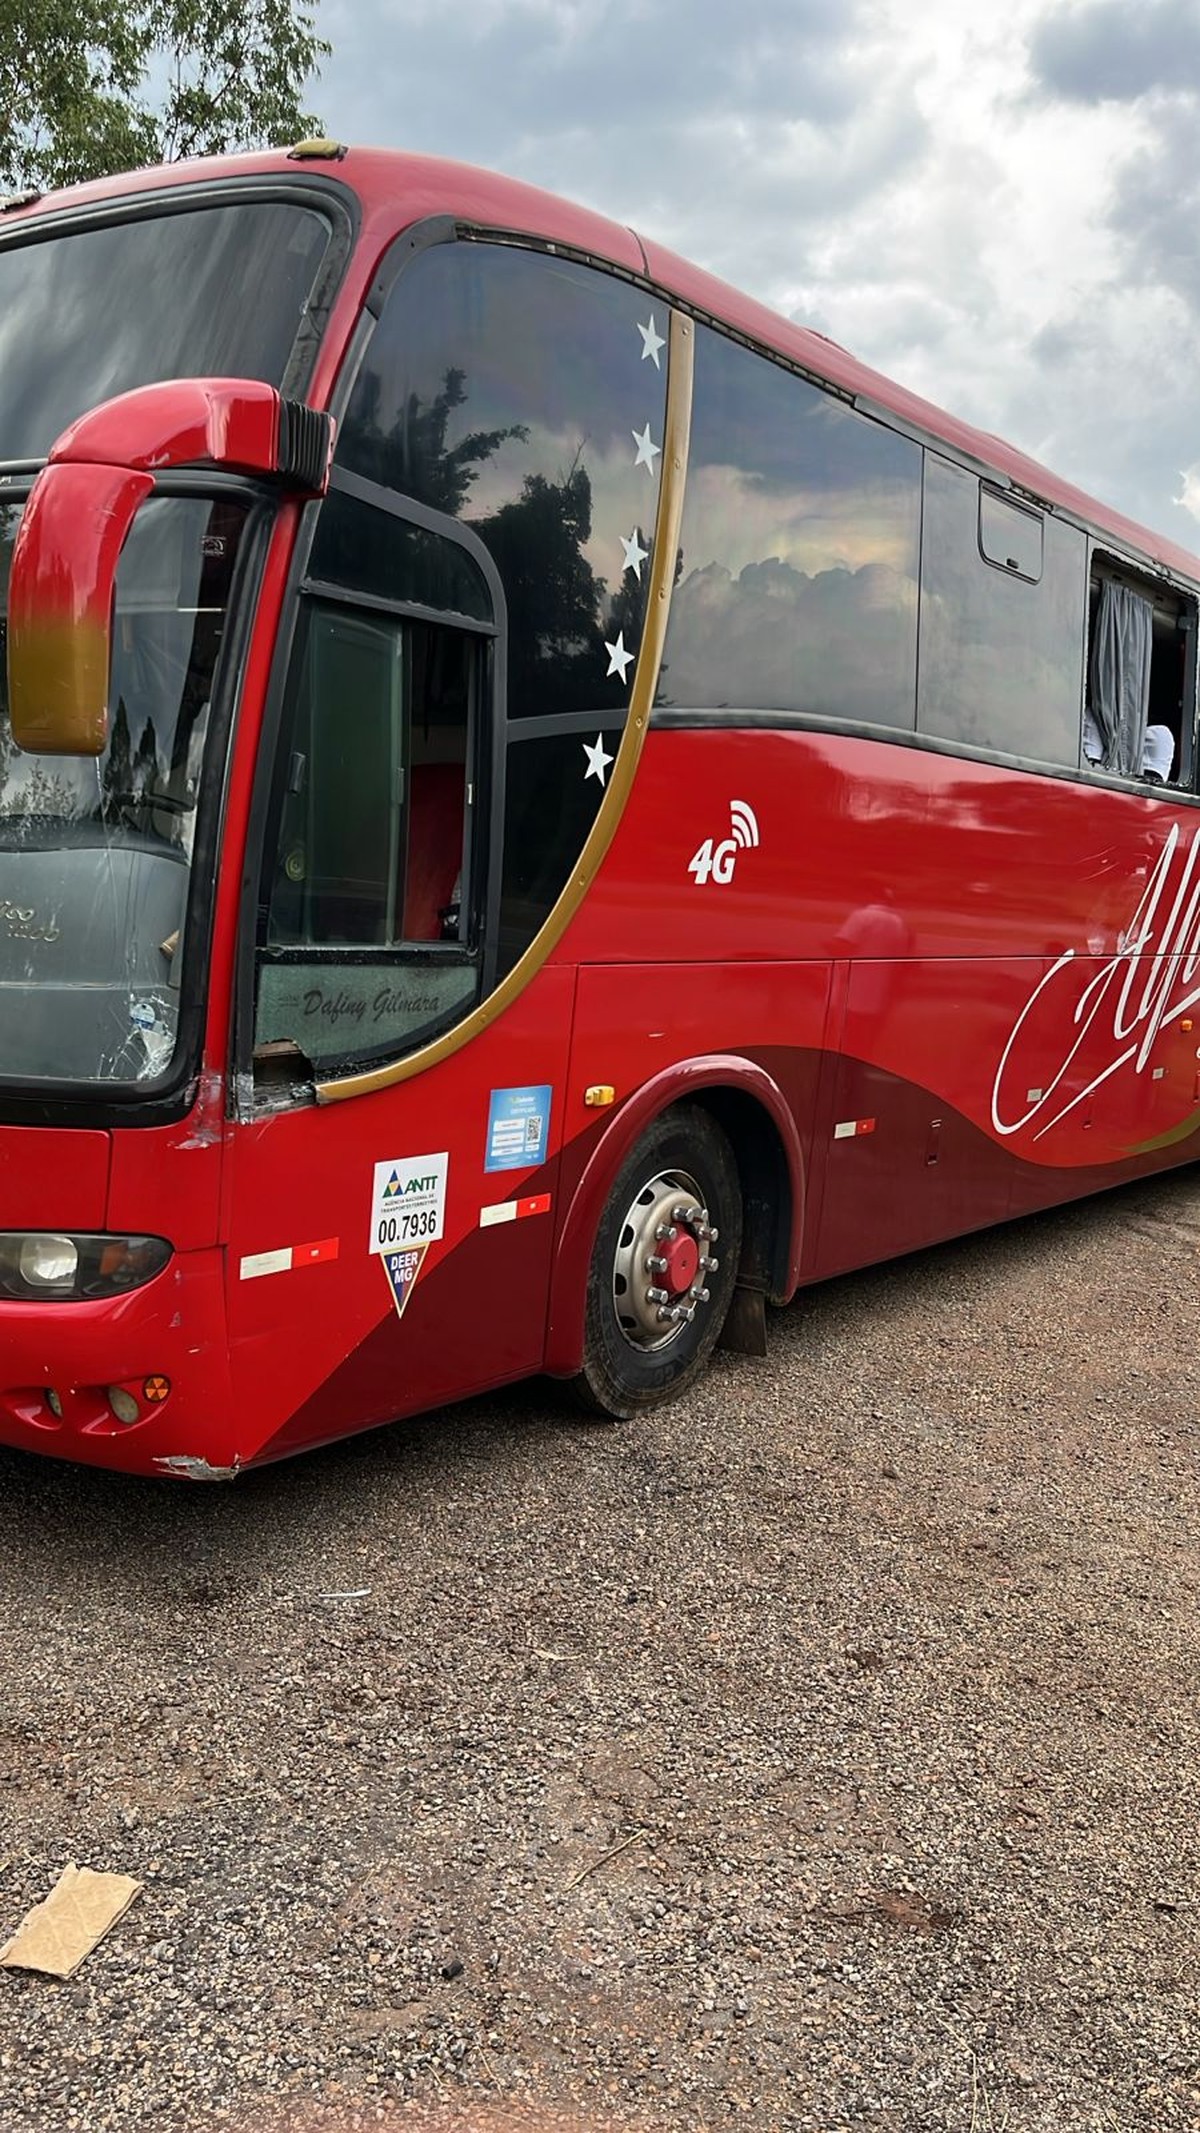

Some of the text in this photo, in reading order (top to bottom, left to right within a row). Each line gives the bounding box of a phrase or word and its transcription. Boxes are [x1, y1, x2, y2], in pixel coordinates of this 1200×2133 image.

[687, 838, 738, 885] 4G
[372, 987, 440, 1023] Gilmara
[404, 1175, 438, 1195] ANTT
[378, 1210, 437, 1244] 00.7936
[391, 1252, 418, 1270] DEER
[394, 1268, 413, 1284] MG
